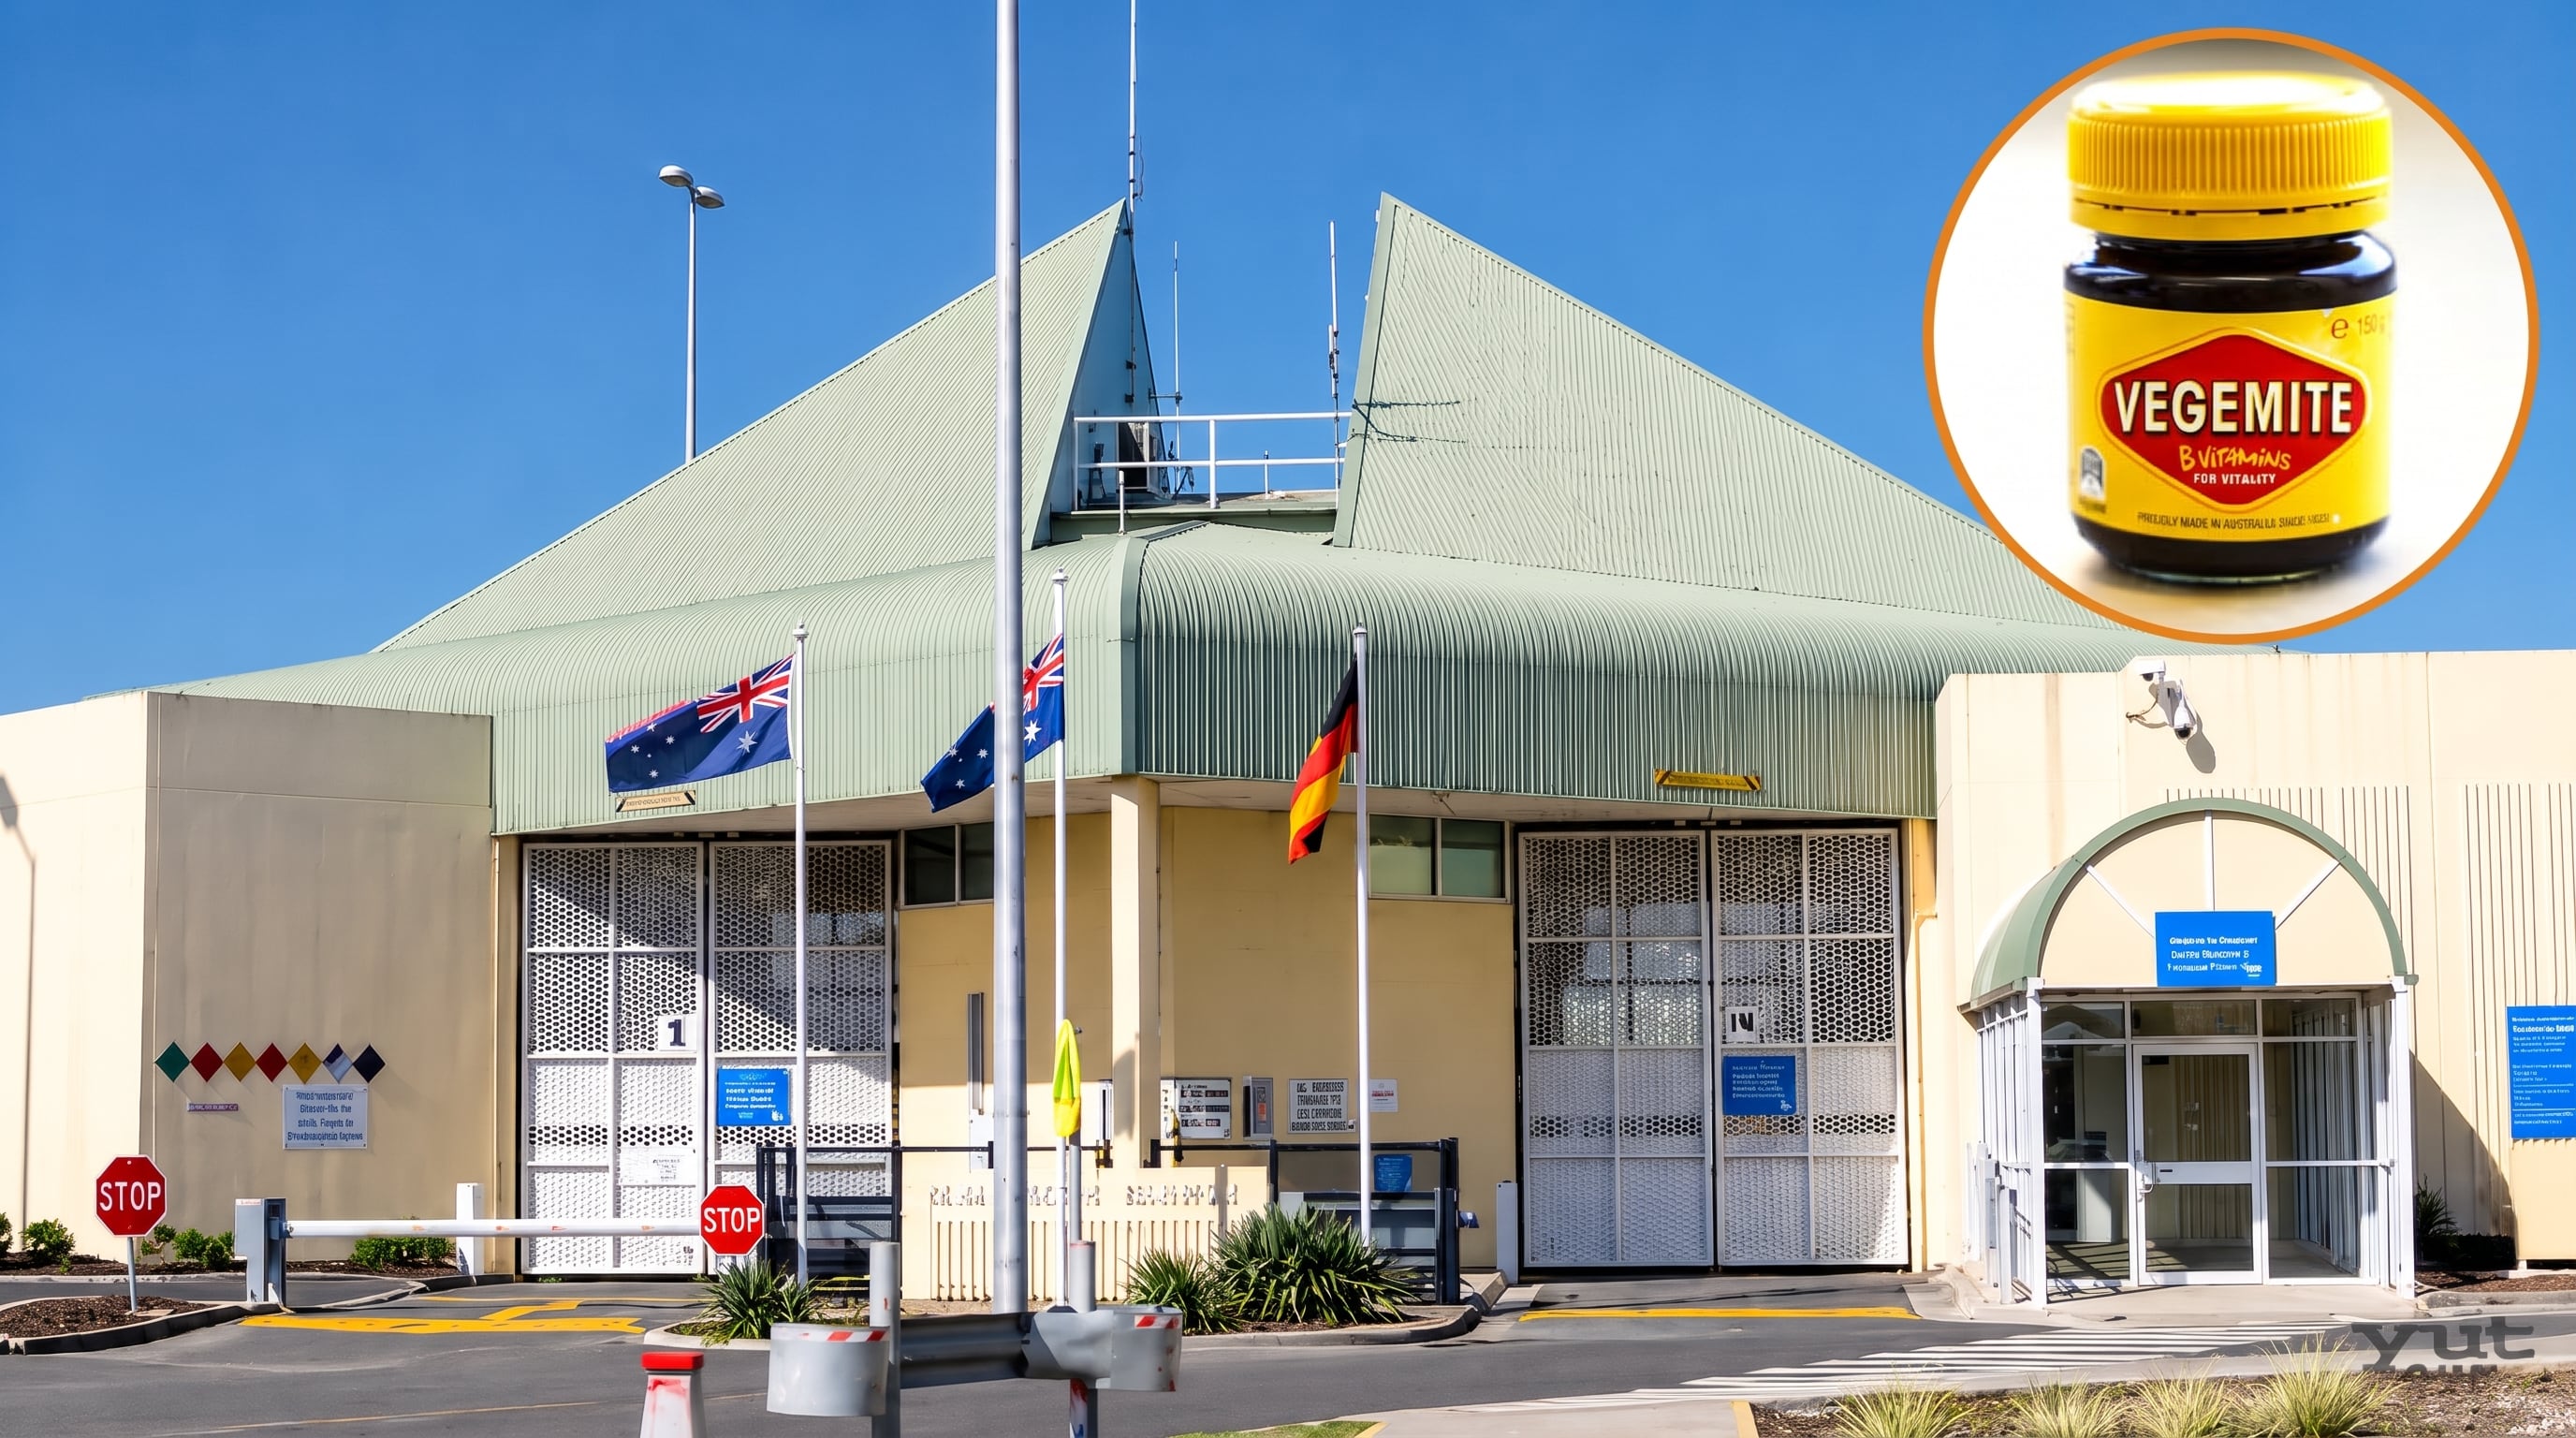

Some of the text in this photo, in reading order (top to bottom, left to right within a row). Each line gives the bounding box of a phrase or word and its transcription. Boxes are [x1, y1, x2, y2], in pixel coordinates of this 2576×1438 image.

[2114, 380, 2352, 434] VEGEMITE
[2193, 473, 2276, 484] FOR VITALITY
[667, 1019, 686, 1047] 1
[100, 1181, 161, 1211] STOP
[704, 1207, 761, 1234] STOP
